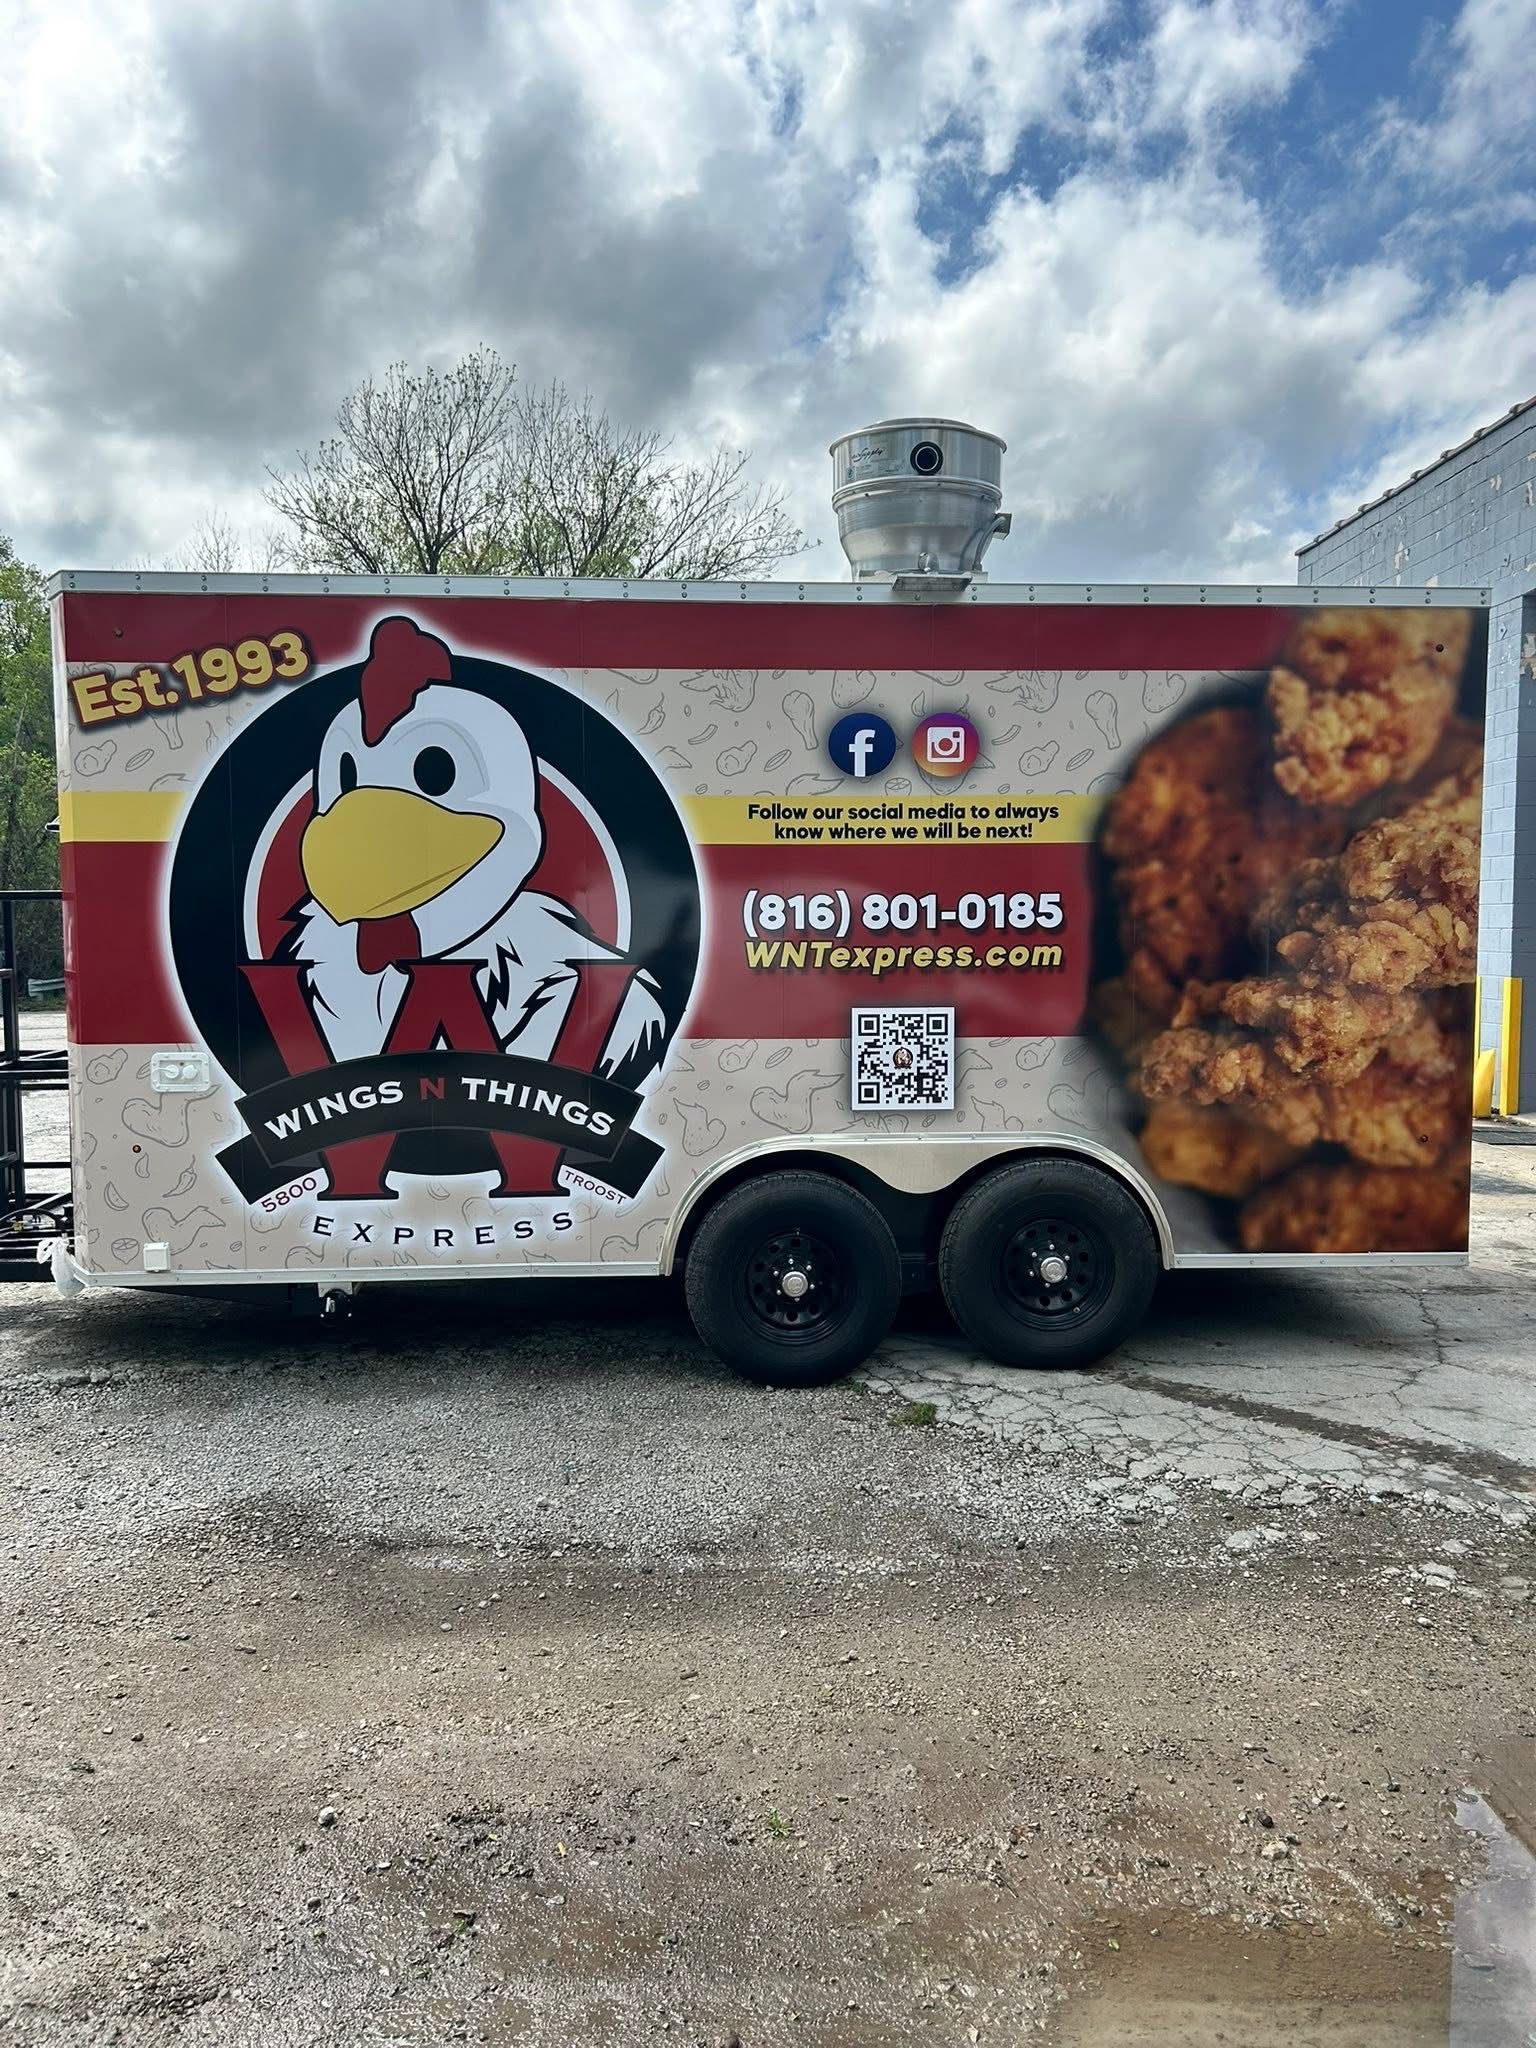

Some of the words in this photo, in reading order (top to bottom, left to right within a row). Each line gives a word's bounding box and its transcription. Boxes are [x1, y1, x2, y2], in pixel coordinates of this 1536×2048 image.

[70, 629, 310, 726] Est.1993
[749, 804, 808, 820] Follow
[812, 807, 846, 820] our
[848, 803, 904, 820] social
[908, 803, 966, 819] media
[970, 804, 991, 819] to
[995, 803, 1060, 823] always
[774, 822, 823, 839] know
[828, 822, 887, 839] where
[891, 826, 918, 839] we
[923, 822, 953, 838] will
[957, 822, 982, 839] be
[985, 822, 1033, 839] next!
[742, 889, 851, 938] (816)
[861, 893, 1064, 931] 801-0185
[744, 941, 1064, 976] WNTexpress.com
[263, 1079, 405, 1141] WINGS
[419, 1077, 446, 1101] N
[460, 1076, 617, 1137] THINGS
[261, 1175, 318, 1214] 5800
[563, 1169, 627, 1206] TROOST
[312, 1211, 574, 1248] EXPRESS
